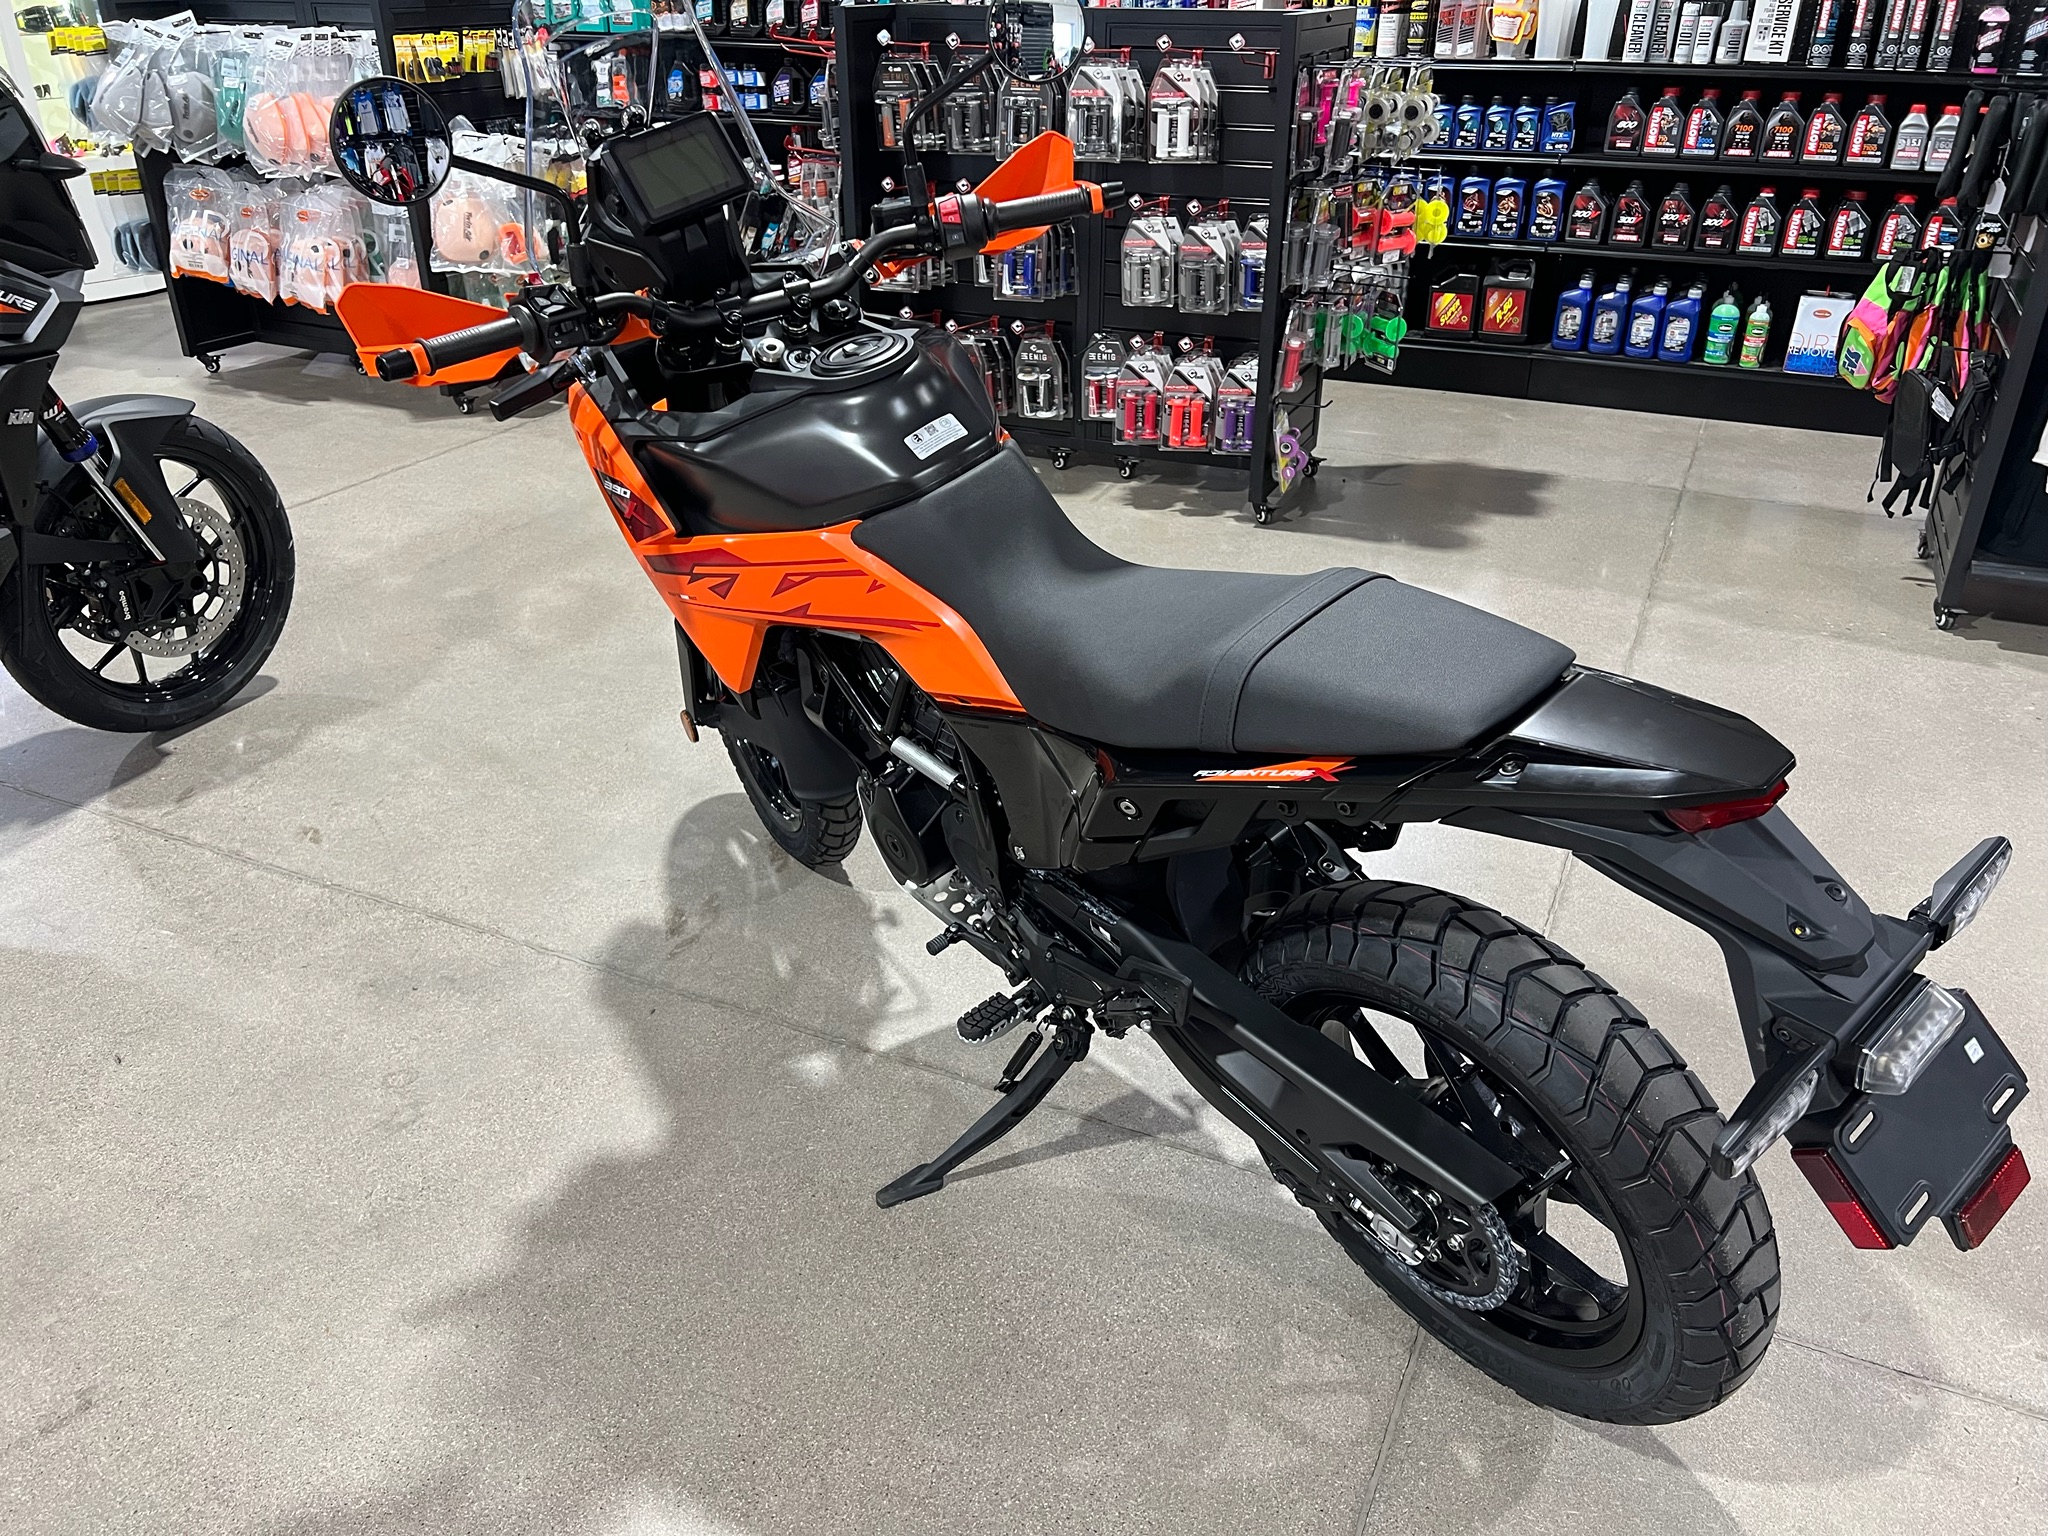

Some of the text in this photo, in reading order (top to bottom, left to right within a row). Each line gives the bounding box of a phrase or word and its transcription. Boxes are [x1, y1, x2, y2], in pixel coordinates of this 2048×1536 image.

[1627, 13, 1648, 54] CLEANER
[1651, 14, 1671, 54] CLEANER
[1767, 0, 1793, 56] SERVICE KIT
[1678, 31, 1693, 50] OIL
[1697, 31, 1712, 48] OIL
[1726, 40, 1741, 55] OIL
[1647, 110, 1661, 144] MOTUL
[1687, 112, 1701, 146] MOTUL
[1734, 124, 1754, 132] 7100
[1773, 126, 1794, 134] 7100
[1807, 118, 1823, 152] MOTUL
[1851, 119, 1867, 154] MOTUL
[465, 211, 473, 229] Twin
[1572, 210, 1601, 219] 300V
[1617, 216, 1643, 224] 300V
[1660, 213, 1688, 221] 300V
[1703, 218, 1733, 227] 300V
[1743, 211, 1758, 243] MOTUL
[1786, 213, 1801, 246] MOTUL
[1831, 214, 1847, 247] MOTUL
[1881, 218, 1897, 252] MOTUL
[1924, 221, 1940, 249] OTUL
[1029, 353, 1047, 361] EMIG
[1097, 353, 1116, 361] EMIG
[1788, 345, 1834, 358] REMOVE
[7, 408, 35, 426] KTM
[603, 480, 631, 499] 390
[118, 590, 131, 620] brembo
